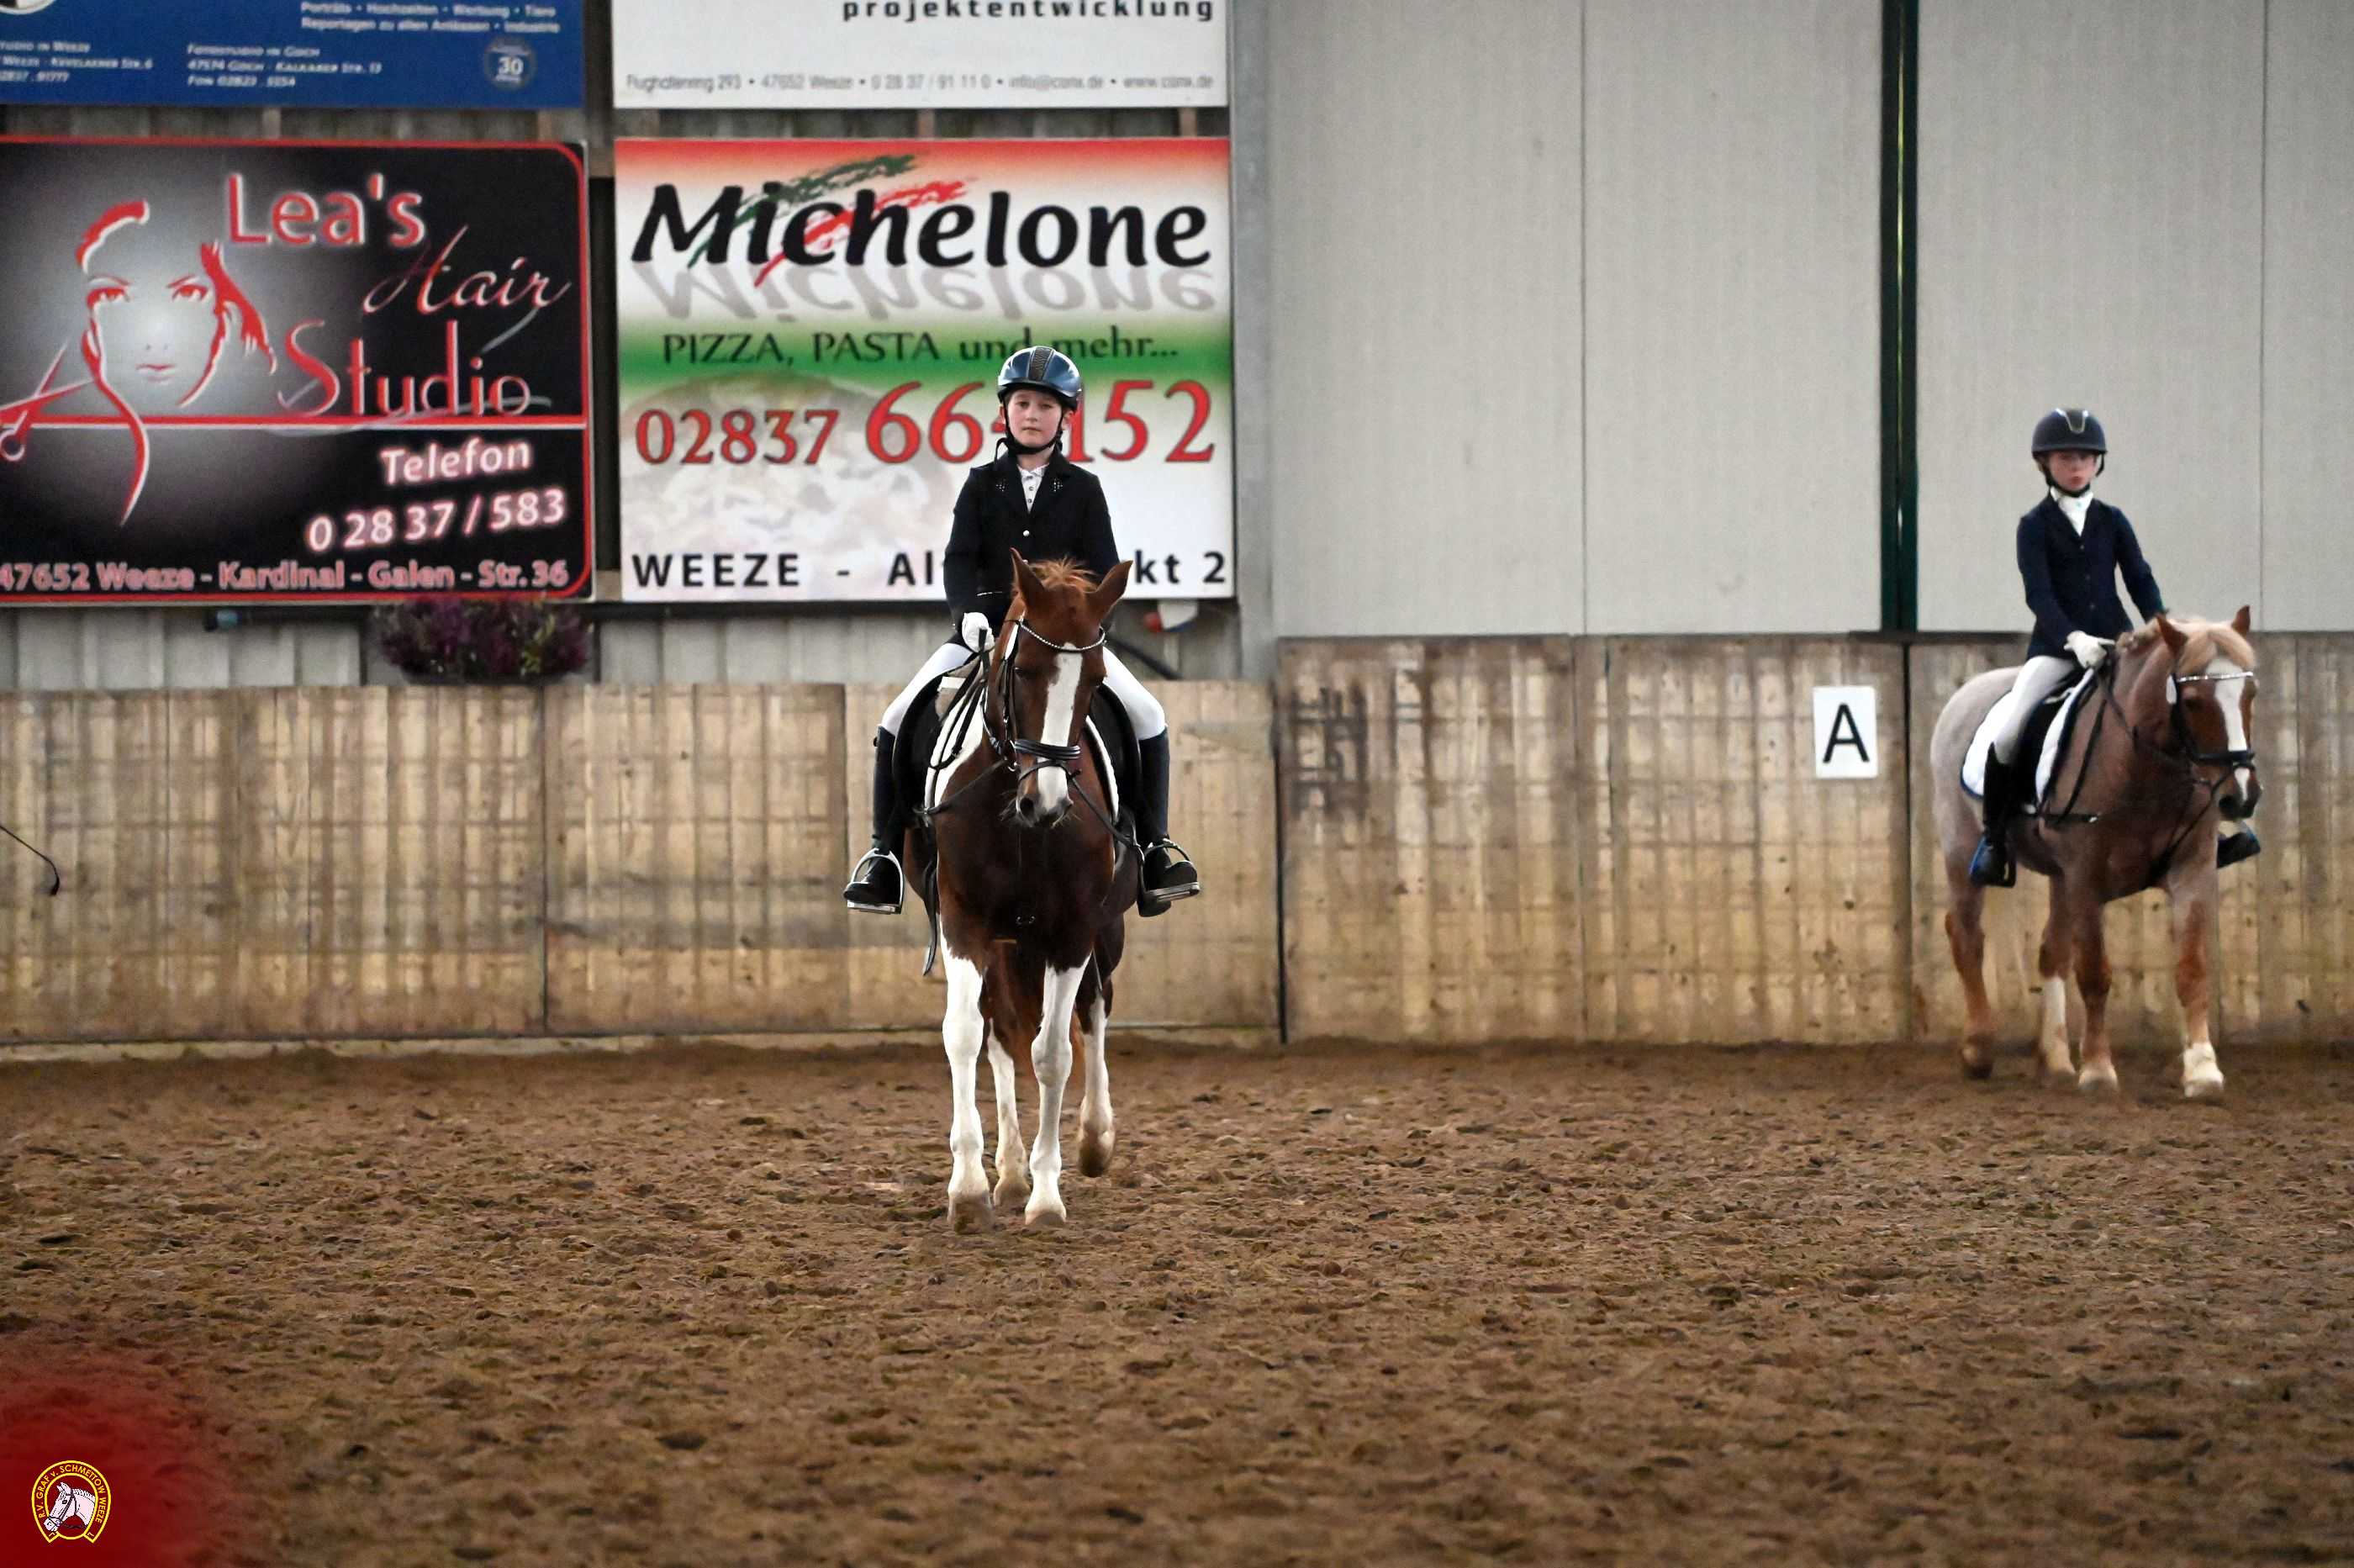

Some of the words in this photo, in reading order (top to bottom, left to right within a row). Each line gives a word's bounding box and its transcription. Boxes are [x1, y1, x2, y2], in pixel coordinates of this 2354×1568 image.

[228, 172, 425, 245] Lea's
[631, 182, 1212, 267] Michelone
[362, 224, 572, 314] Hair
[278, 319, 533, 417] Studio
[663, 334, 794, 367] PIZZA,
[813, 330, 939, 363] PASTA
[636, 409, 839, 465] 02837
[866, 380, 1215, 464] 66152
[381, 438, 530, 484] Telefon
[308, 516, 332, 552] 0
[343, 507, 394, 549] 28
[407, 500, 453, 541] 37
[492, 488, 566, 531] 583
[0, 562, 90, 590] 47652
[96, 561, 195, 590] Weeze
[219, 560, 345, 590] Kardinal
[368, 560, 455, 589] Galen
[478, 559, 527, 587] Str.
[532, 559, 567, 587] 36
[632, 553, 800, 588] WEEZE
[1202, 551, 1225, 583] 2
[1823, 703, 1870, 763] A
